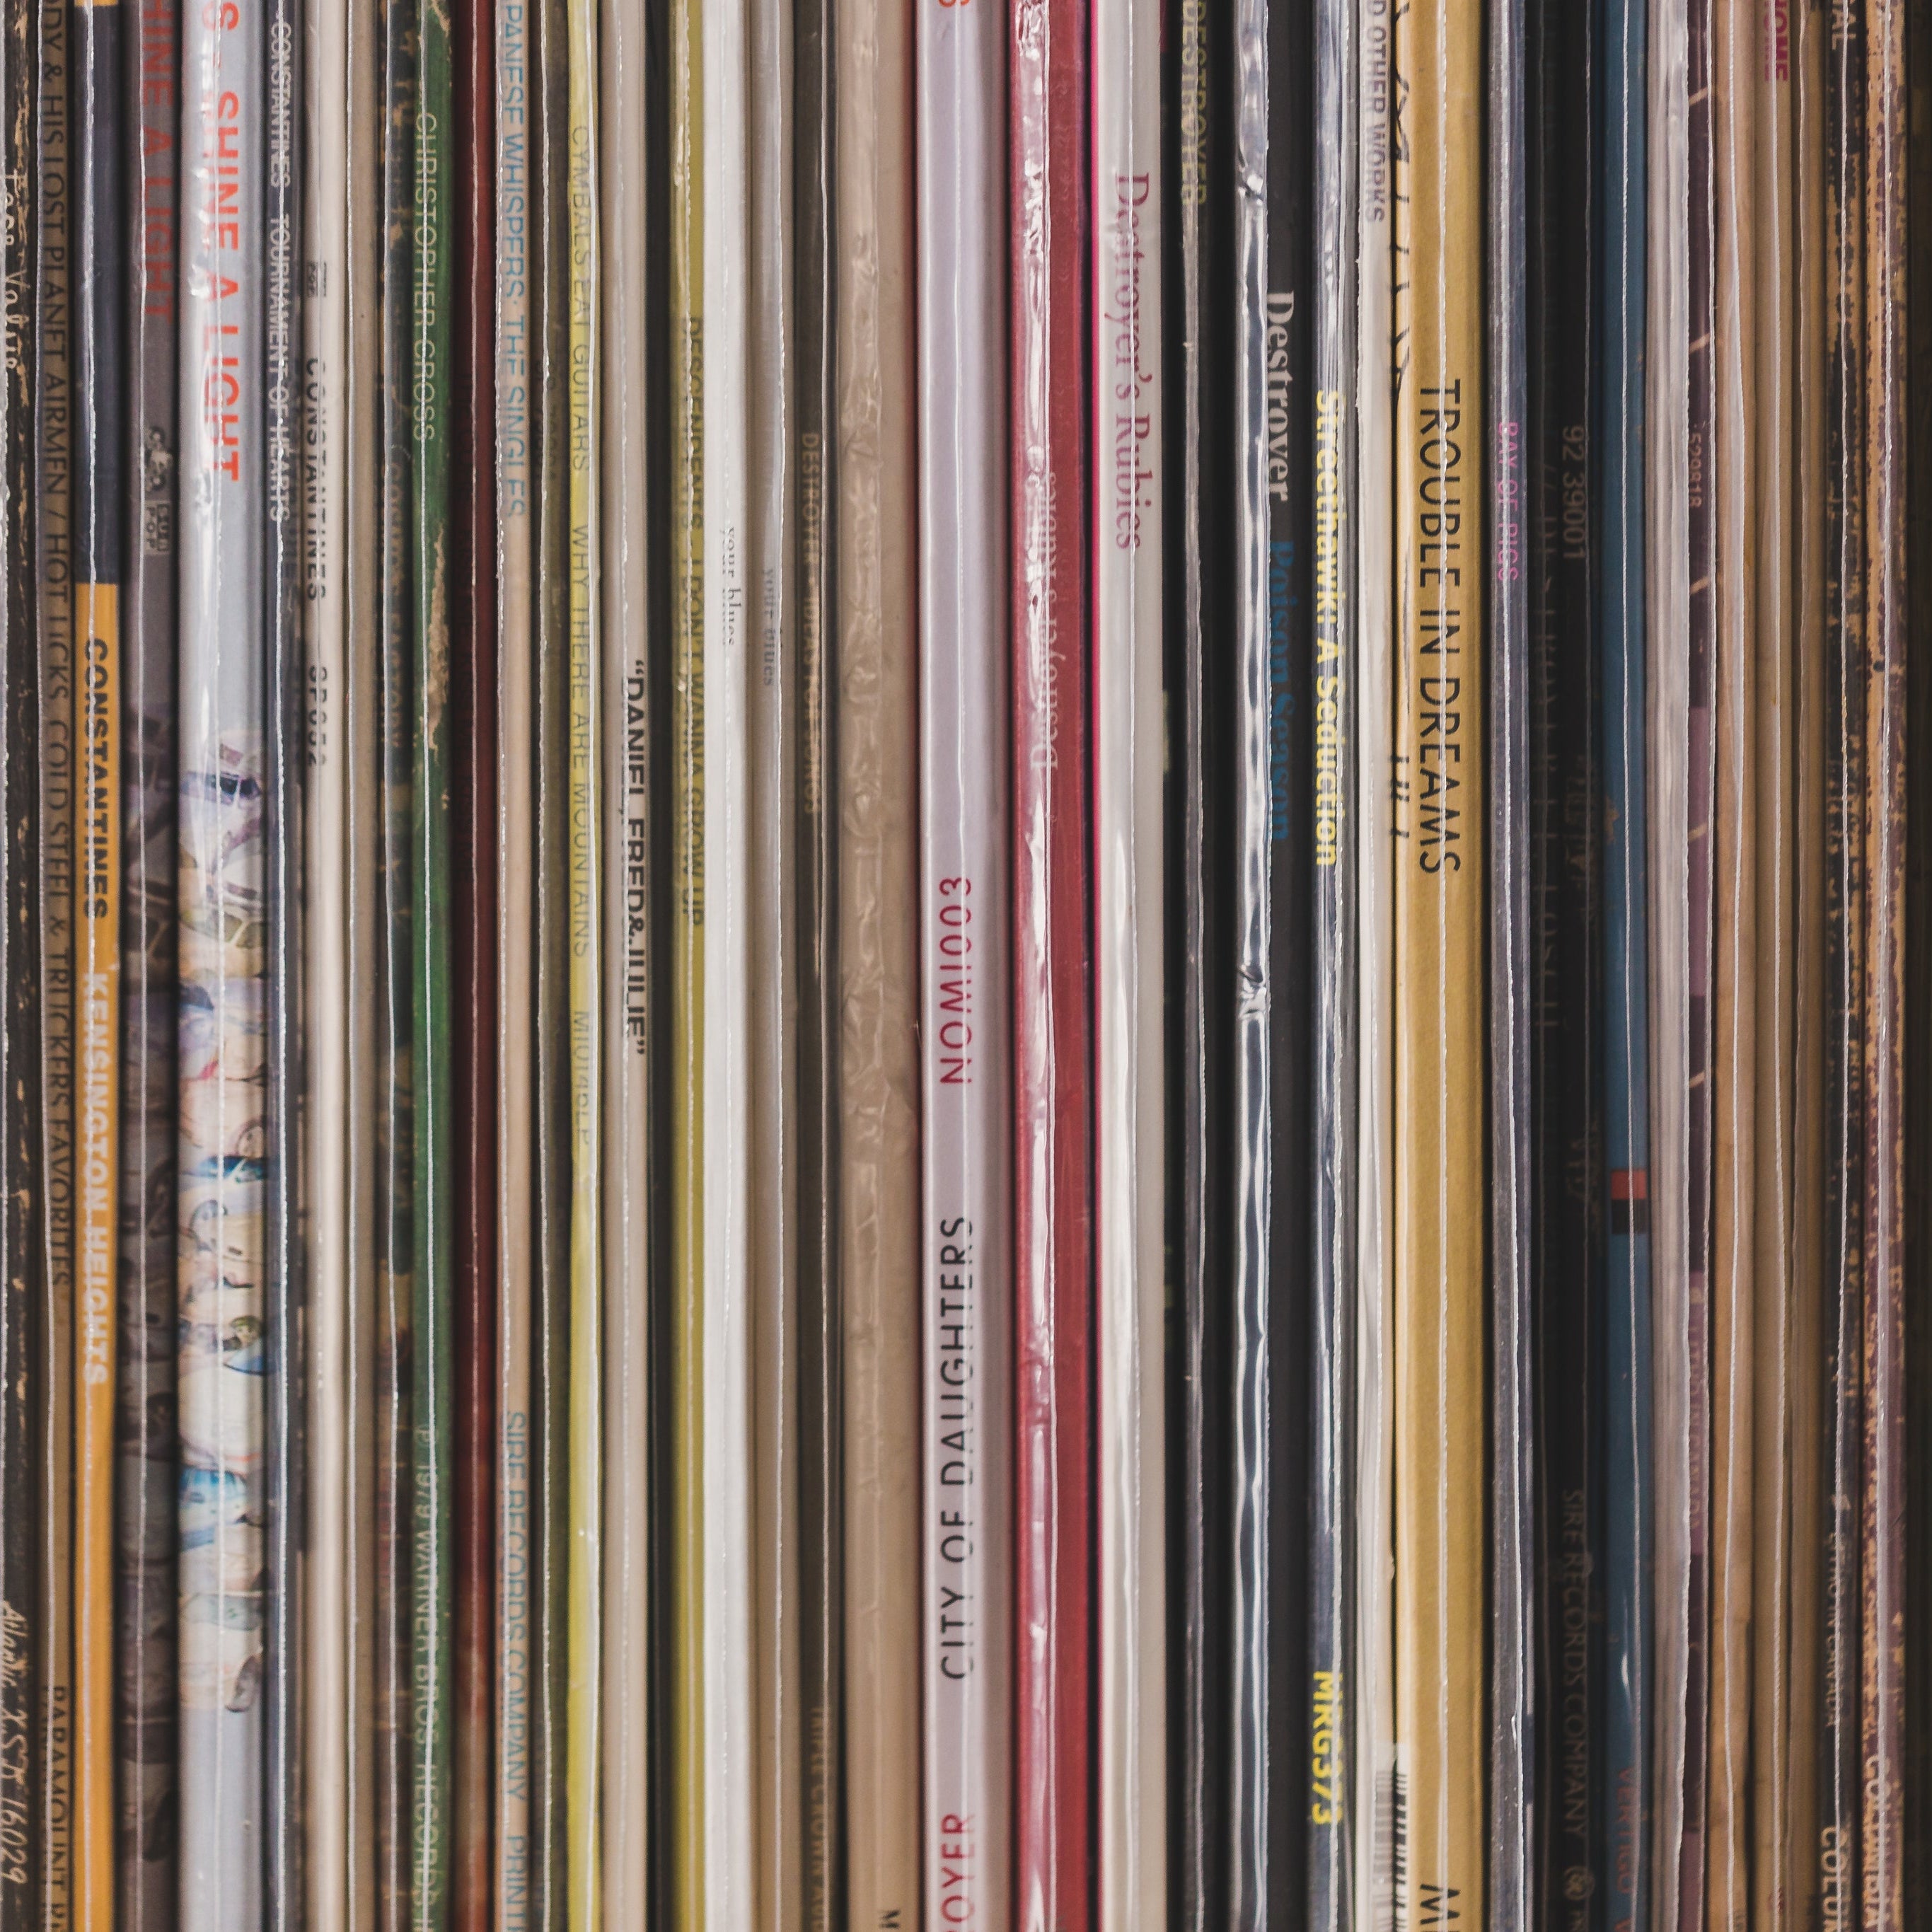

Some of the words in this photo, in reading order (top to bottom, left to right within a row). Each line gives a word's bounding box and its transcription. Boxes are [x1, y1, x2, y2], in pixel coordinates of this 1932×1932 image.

[42, 0, 65, 51] DY
[42, 62, 65, 83] &
[503, 5, 524, 125] PANESE
[1365, 25, 1387, 114] OTHER
[1832, 0, 1856, 51] AL
[42, 96, 65, 144] HIS
[144, 125, 173, 156] A
[270, 21, 291, 187] CONSTANTINES
[1182, 0, 1207, 206] DESTROYER
[42, 157, 65, 235] LOST
[203, 91, 239, 250] SHINE
[414, 112, 436, 327] CHRISTOPHER
[572, 127, 591, 266] CYMBALS
[1365, 123, 1387, 224] WORKS
[41, 246, 64, 361] PLANET
[144, 177, 173, 324] LIGHT
[203, 271, 239, 300] A
[270, 213, 291, 379] TOURNAMENT
[572, 279, 591, 328] EAT
[203, 325, 239, 482] LIGHT
[269, 386, 290, 419] OF
[414, 339, 436, 441] CROSS
[503, 315, 524, 376] THE
[40, 371, 64, 495] AIRMEN
[503, 386, 524, 517] SINGLES
[572, 344, 591, 472] GUITARS
[682, 316, 703, 530] DESCENDENTS
[1497, 421, 1519, 469] BAY
[1562, 424, 1585, 462] 92
[269, 426, 290, 521] HEARTS
[306, 357, 327, 601] CONSTANTINES
[802, 432, 819, 565] DESTROYER
[1116, 412, 1153, 550] Rubies
[1317, 390, 1342, 624] Streethawk:
[1419, 378, 1462, 589] TROUBLE
[1497, 479, 1519, 512] OF
[1562, 471, 1585, 561] 39001
[43, 533, 66, 603] HOT
[572, 525, 591, 589] WHY
[720, 526, 736, 579] your
[1271, 540, 1297, 683] Poison
[1497, 523, 1519, 582] PIGS
[44, 615, 66, 700] LICKS
[572, 606, 591, 700] THERE
[723, 586, 742, 647] blues
[1317, 637, 1339, 664] A
[1419, 609, 1462, 654] IN
[45, 719, 67, 809] COLD
[84, 637, 108, 919] CONSTANTINES
[572, 712, 591, 770] ARE
[682, 672, 703, 776] WANNA
[1271, 693, 1295, 840] Season
[1317, 675, 1342, 866] Seduction
[1419, 677, 1462, 874] DREAMS
[45, 821, 67, 897] STEEL
[572, 782, 591, 957] MOUNTAINS
[682, 787, 703, 877] GROW
[682, 888, 703, 927] UP
[47, 947, 69, 1106] TRUCKERS
[940, 877, 971, 1085] NOMI003
[84, 973, 108, 1211] KENSINGTON
[47, 1119, 69, 1286] FAVORITES
[84, 1227, 108, 1386] HEIGHTS
[941, 1217, 974, 1486] DAUGHTERS
[501, 1411, 526, 1480] SIRE
[502, 1490, 526, 1641] RECORDS
[941, 1510, 974, 1563] OF
[1562, 1488, 1585, 1542] SIRE
[415, 1529, 438, 1653] WARNER
[941, 1586, 974, 1680] CITY
[1562, 1551, 1585, 1686] RECORDS
[502, 1649, 526, 1801] COMPANY
[1312, 1670, 1342, 1825] MRG373
[1562, 1694, 1585, 1839] COMPANY
[0, 1796, 28, 1884] 16029
[43, 1685, 68, 1890] PARAMOUNT
[413, 1764, 437, 1906] RECORDS
[1616, 1766, 1635, 1895] VERTIGO
[942, 1813, 975, 1932] OYER
